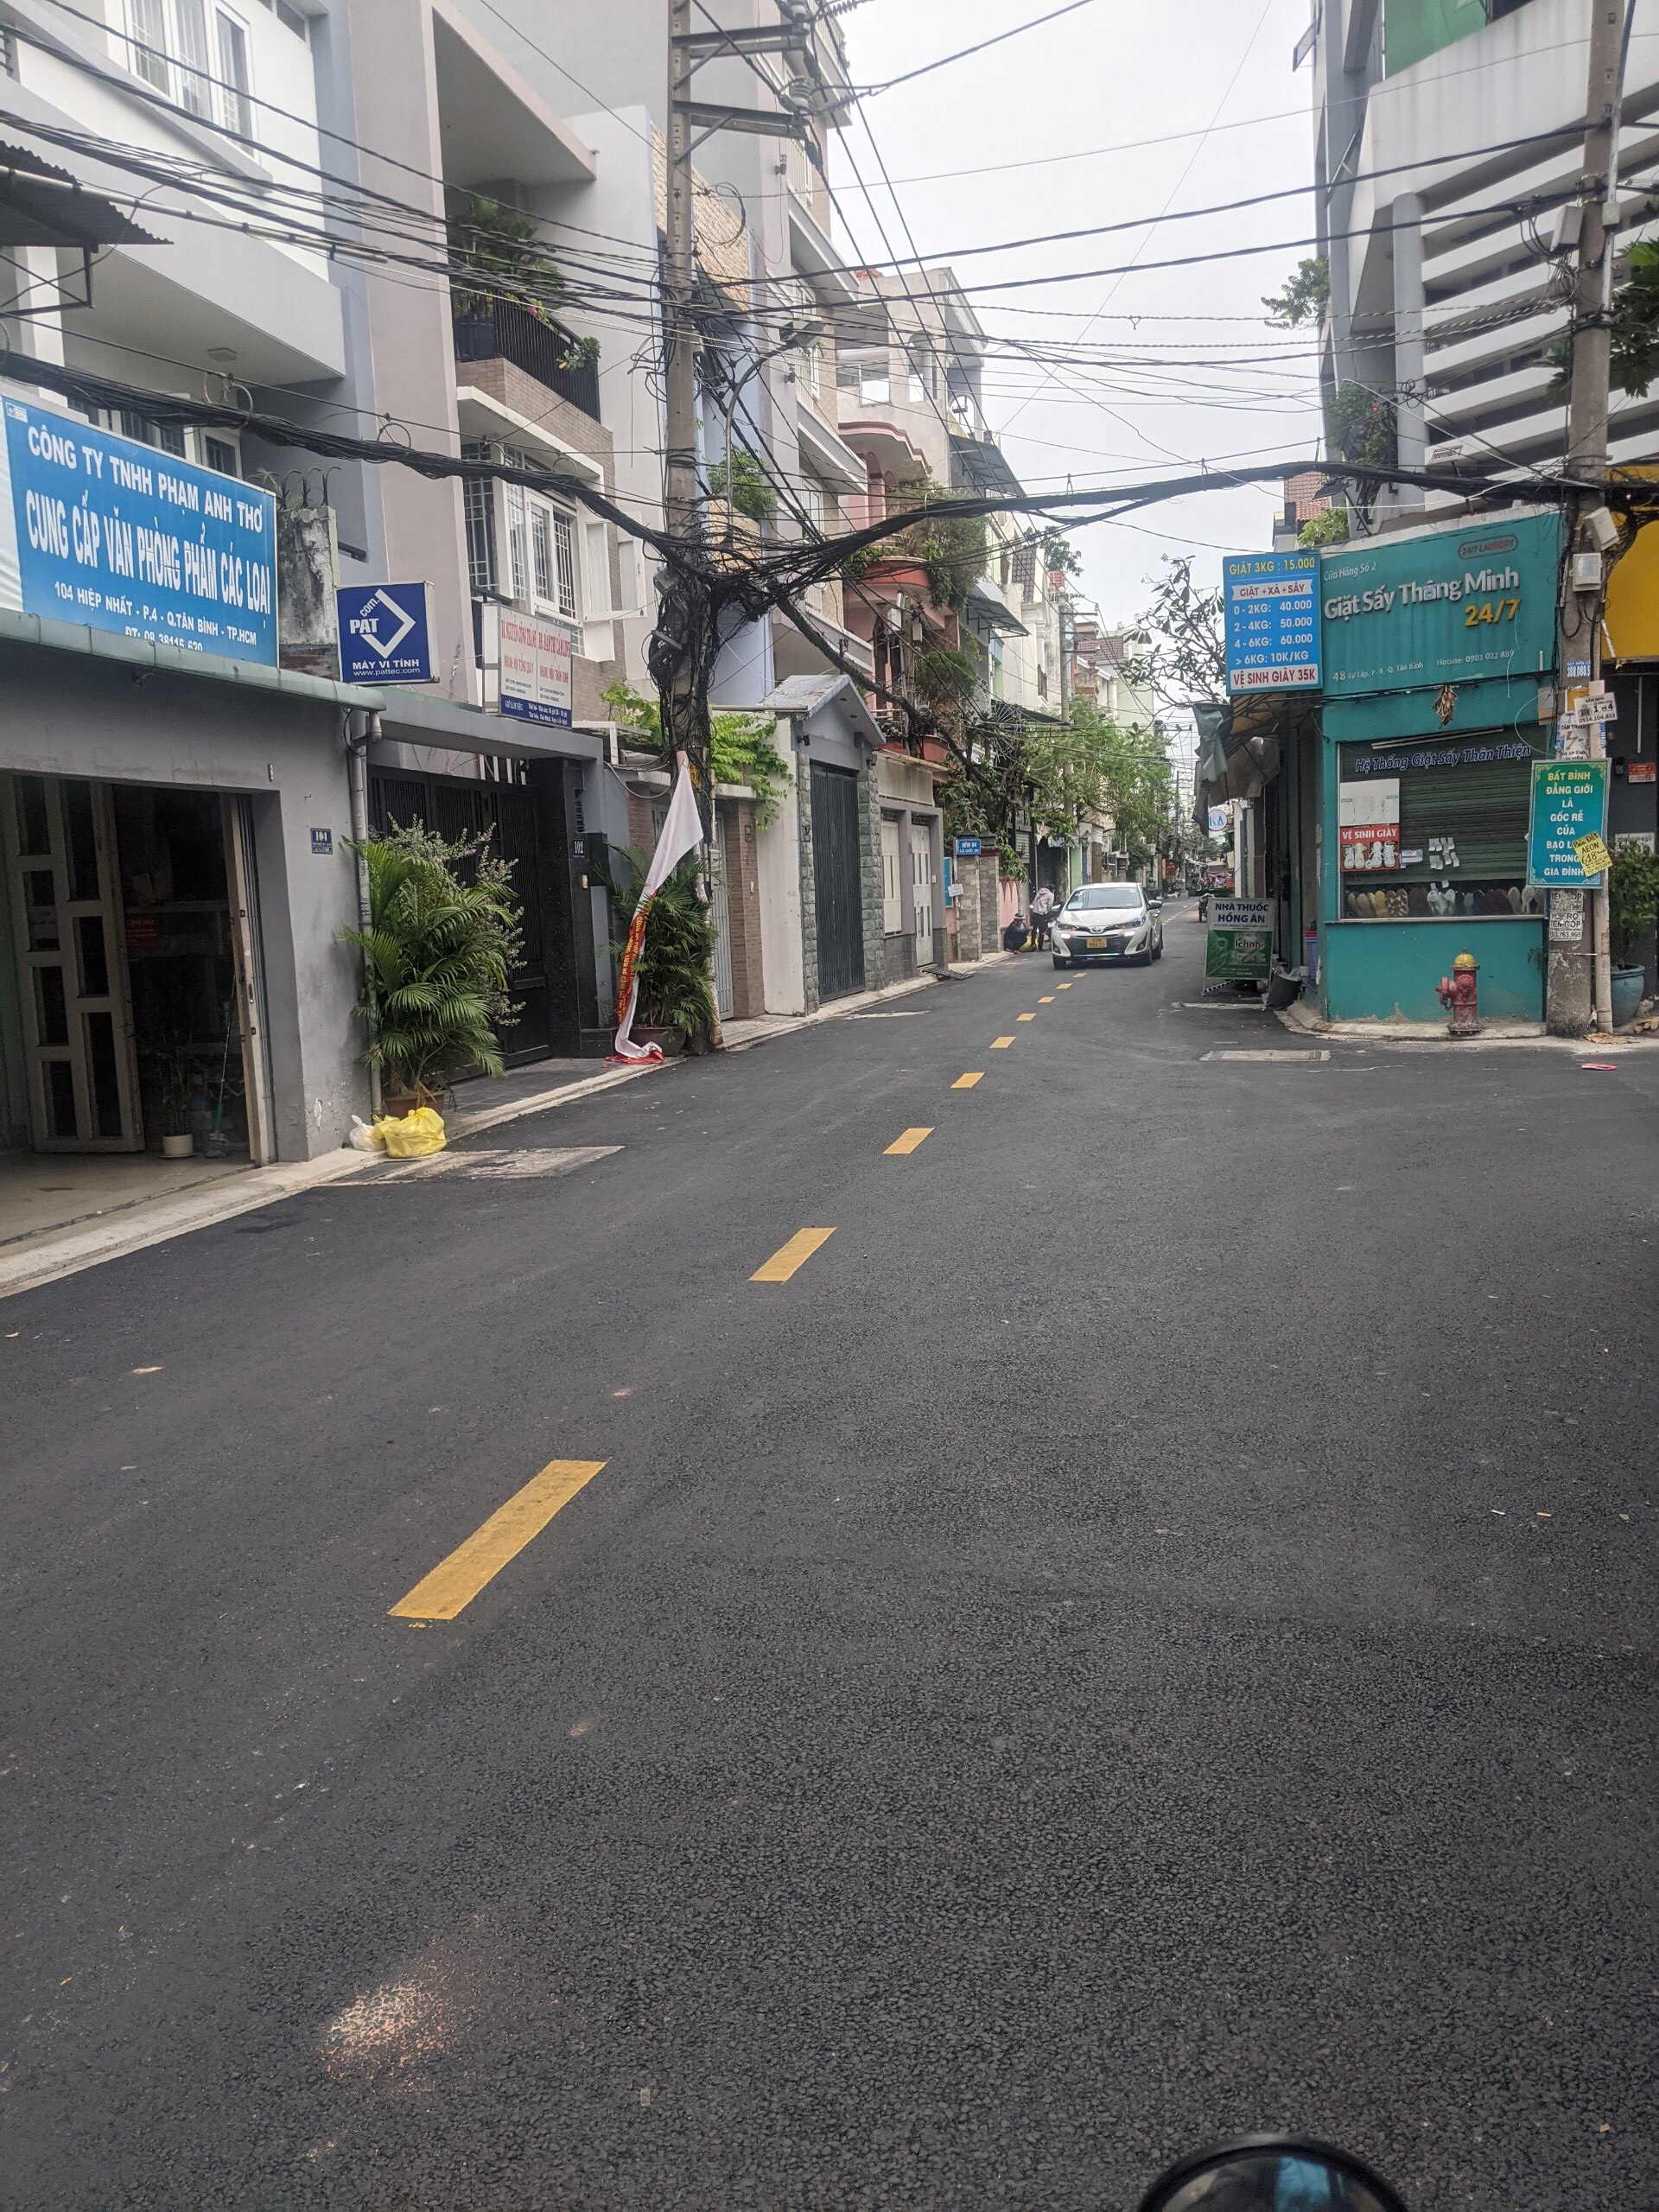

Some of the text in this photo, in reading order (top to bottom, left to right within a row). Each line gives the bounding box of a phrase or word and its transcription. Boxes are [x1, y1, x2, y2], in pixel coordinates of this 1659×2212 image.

[28, 424, 263, 533] CÔNG TY TNHH PHẠM ANH THƠ
[26, 489, 271, 629] CUNG CẤP VĂN PHÒNG PHẨM CÁC LOẠI
[1229, 562, 1251, 577] GIẶT
[1255, 561, 1274, 573] 3KG
[1284, 557, 1315, 570] 15.000
[1370, 562, 1376, 571] 2
[1239, 586, 1259, 599] GIẶT
[1324, 594, 1361, 621] Giặt
[1362, 584, 1395, 613] Sấy
[1465, 566, 1520, 595] Minh
[54, 581, 73, 601] 104
[77, 588, 102, 611] HIỆP
[105, 595, 133, 616] NHẤT
[143, 605, 157, 622] P.4
[167, 610, 194, 631] Q.TÂN
[197, 616, 219, 636] BÌNH
[226, 626, 257, 645] TP.HCM
[1233, 606, 1239, 614] 0
[1248, 603, 1272, 614] 2KG:
[1280, 600, 1312, 612] 40.000
[1465, 598, 1521, 626] 24/7
[349, 618, 379, 634] PAT
[1234, 622, 1240, 632] 2
[1249, 620, 1272, 631] 4KG:
[1280, 617, 1313, 628] 50.000
[1234, 639, 1241, 648] 4
[1249, 638, 1272, 648] 6KG:
[1280, 633, 1313, 645] 60.000
[1244, 653, 1268, 664] 6KG:
[1271, 651, 1309, 663] 10K/KG
[1437, 657, 1464, 666] Hotline:
[1465, 654, 1484, 663] 0903
[353, 660, 376, 671] MÁY
[394, 658, 420, 667] TÍNH
[353, 667, 421, 677] www.pattec.com
[1233, 664, 1315, 689] VỆ SINH GIÀY 35K
[1332, 671, 1346, 682] 48
[1356, 743, 1531, 774] Hệ Thống Giặt Sấy Thân Thiện
[1548, 769, 1591, 781] BẤT BÌNH
[1546, 781, 1593, 795] ĐẲNG GIỚI
[1562, 797, 1573, 808] LÀ
[1550, 809, 1584, 822] GỐC RỄ
[1342, 827, 1397, 842] VỆ SINH GIÀY
[1556, 823, 1575, 836] CỦA
[1546, 841, 1565, 851] BẠO
[1581, 842, 1599, 855] AEON
[1549, 854, 1580, 862] TRONG
[1544, 865, 1584, 876] GIA ĐÌNH
[1215, 902, 1269, 912] NHÀ THUỐC
[1250, 913, 1265, 923] ÂN
